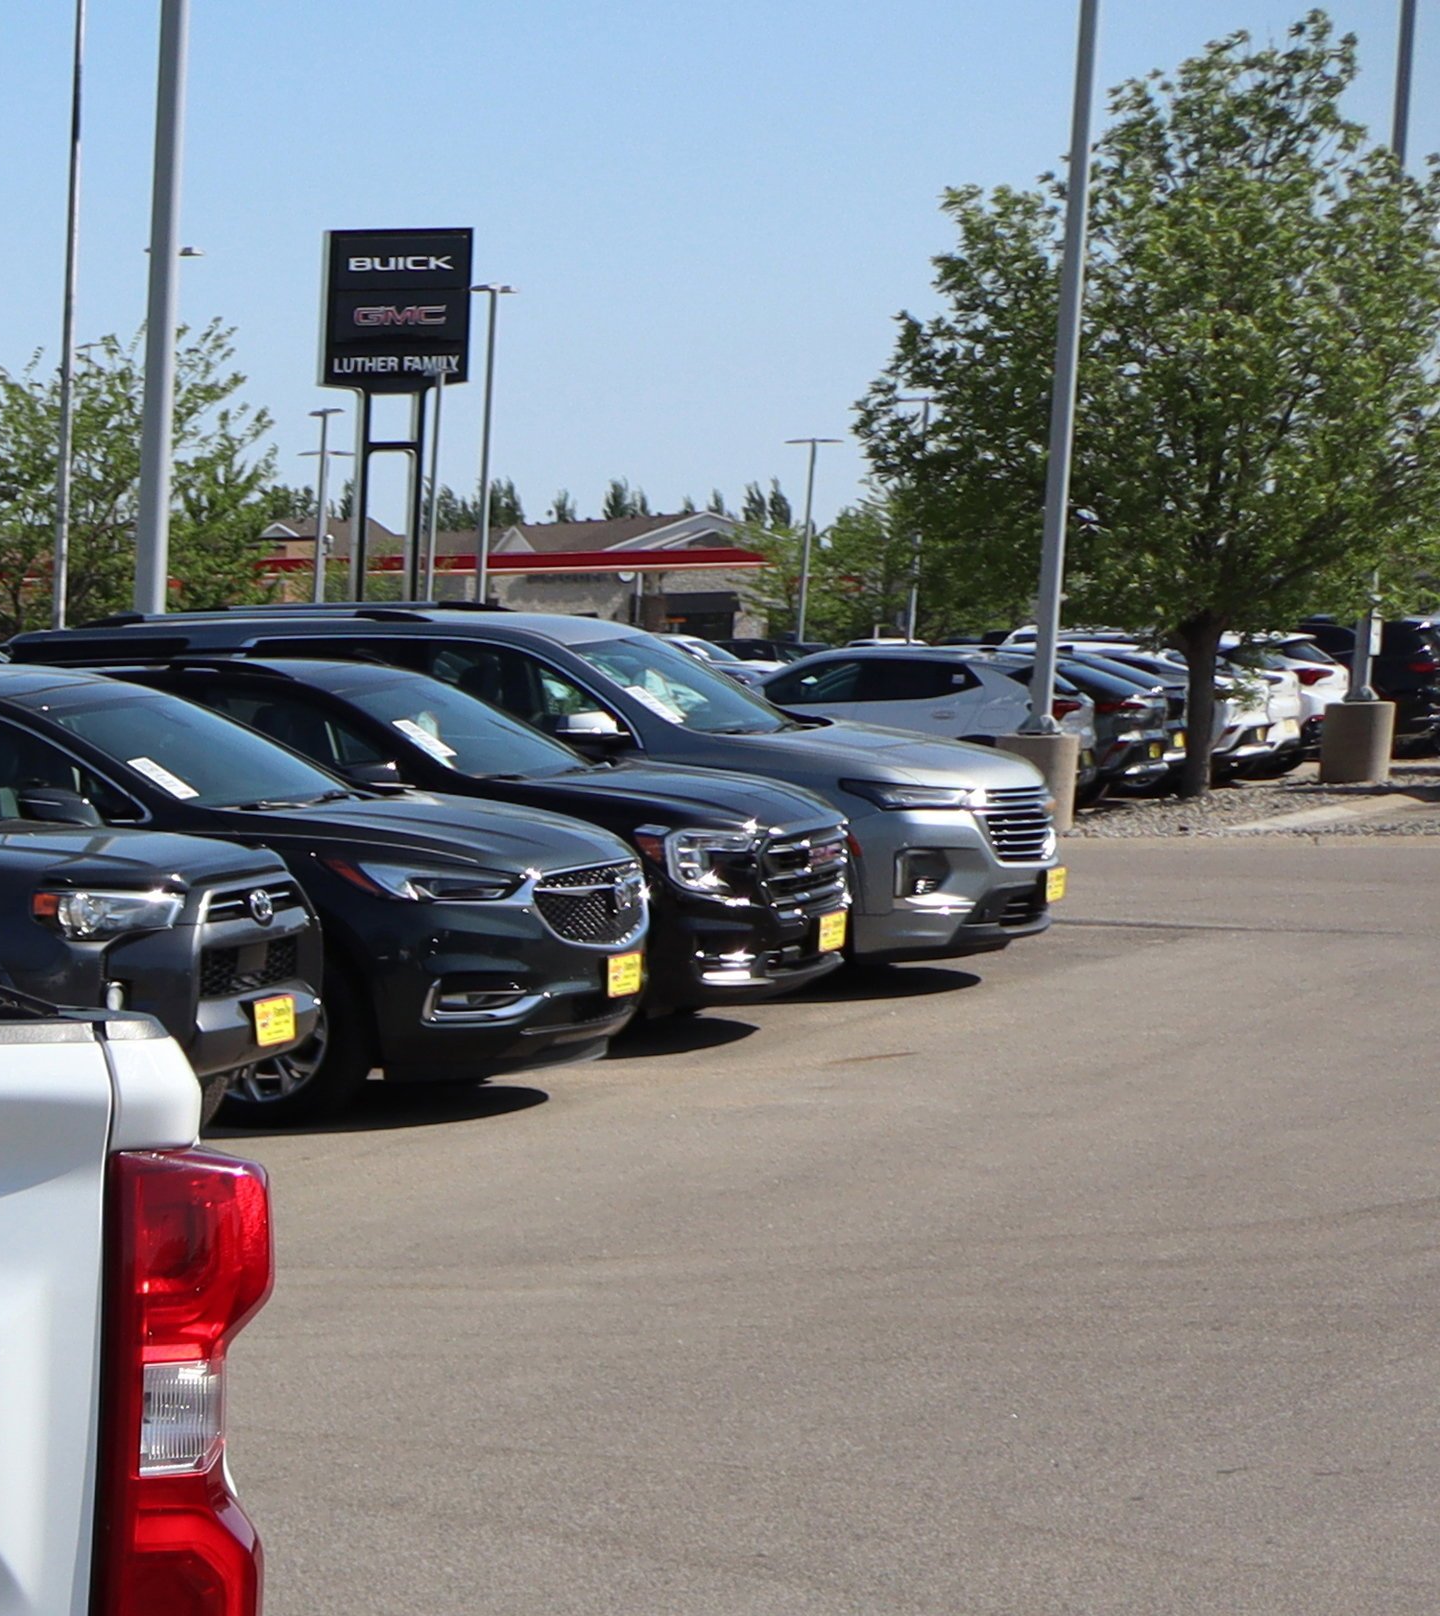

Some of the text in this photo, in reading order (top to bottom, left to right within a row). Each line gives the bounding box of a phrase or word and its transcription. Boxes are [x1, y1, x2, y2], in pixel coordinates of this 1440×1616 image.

[348, 256, 454, 271] BUICK
[353, 305, 447, 326] GMC
[333, 355, 459, 373] LUTHER FAMILY
